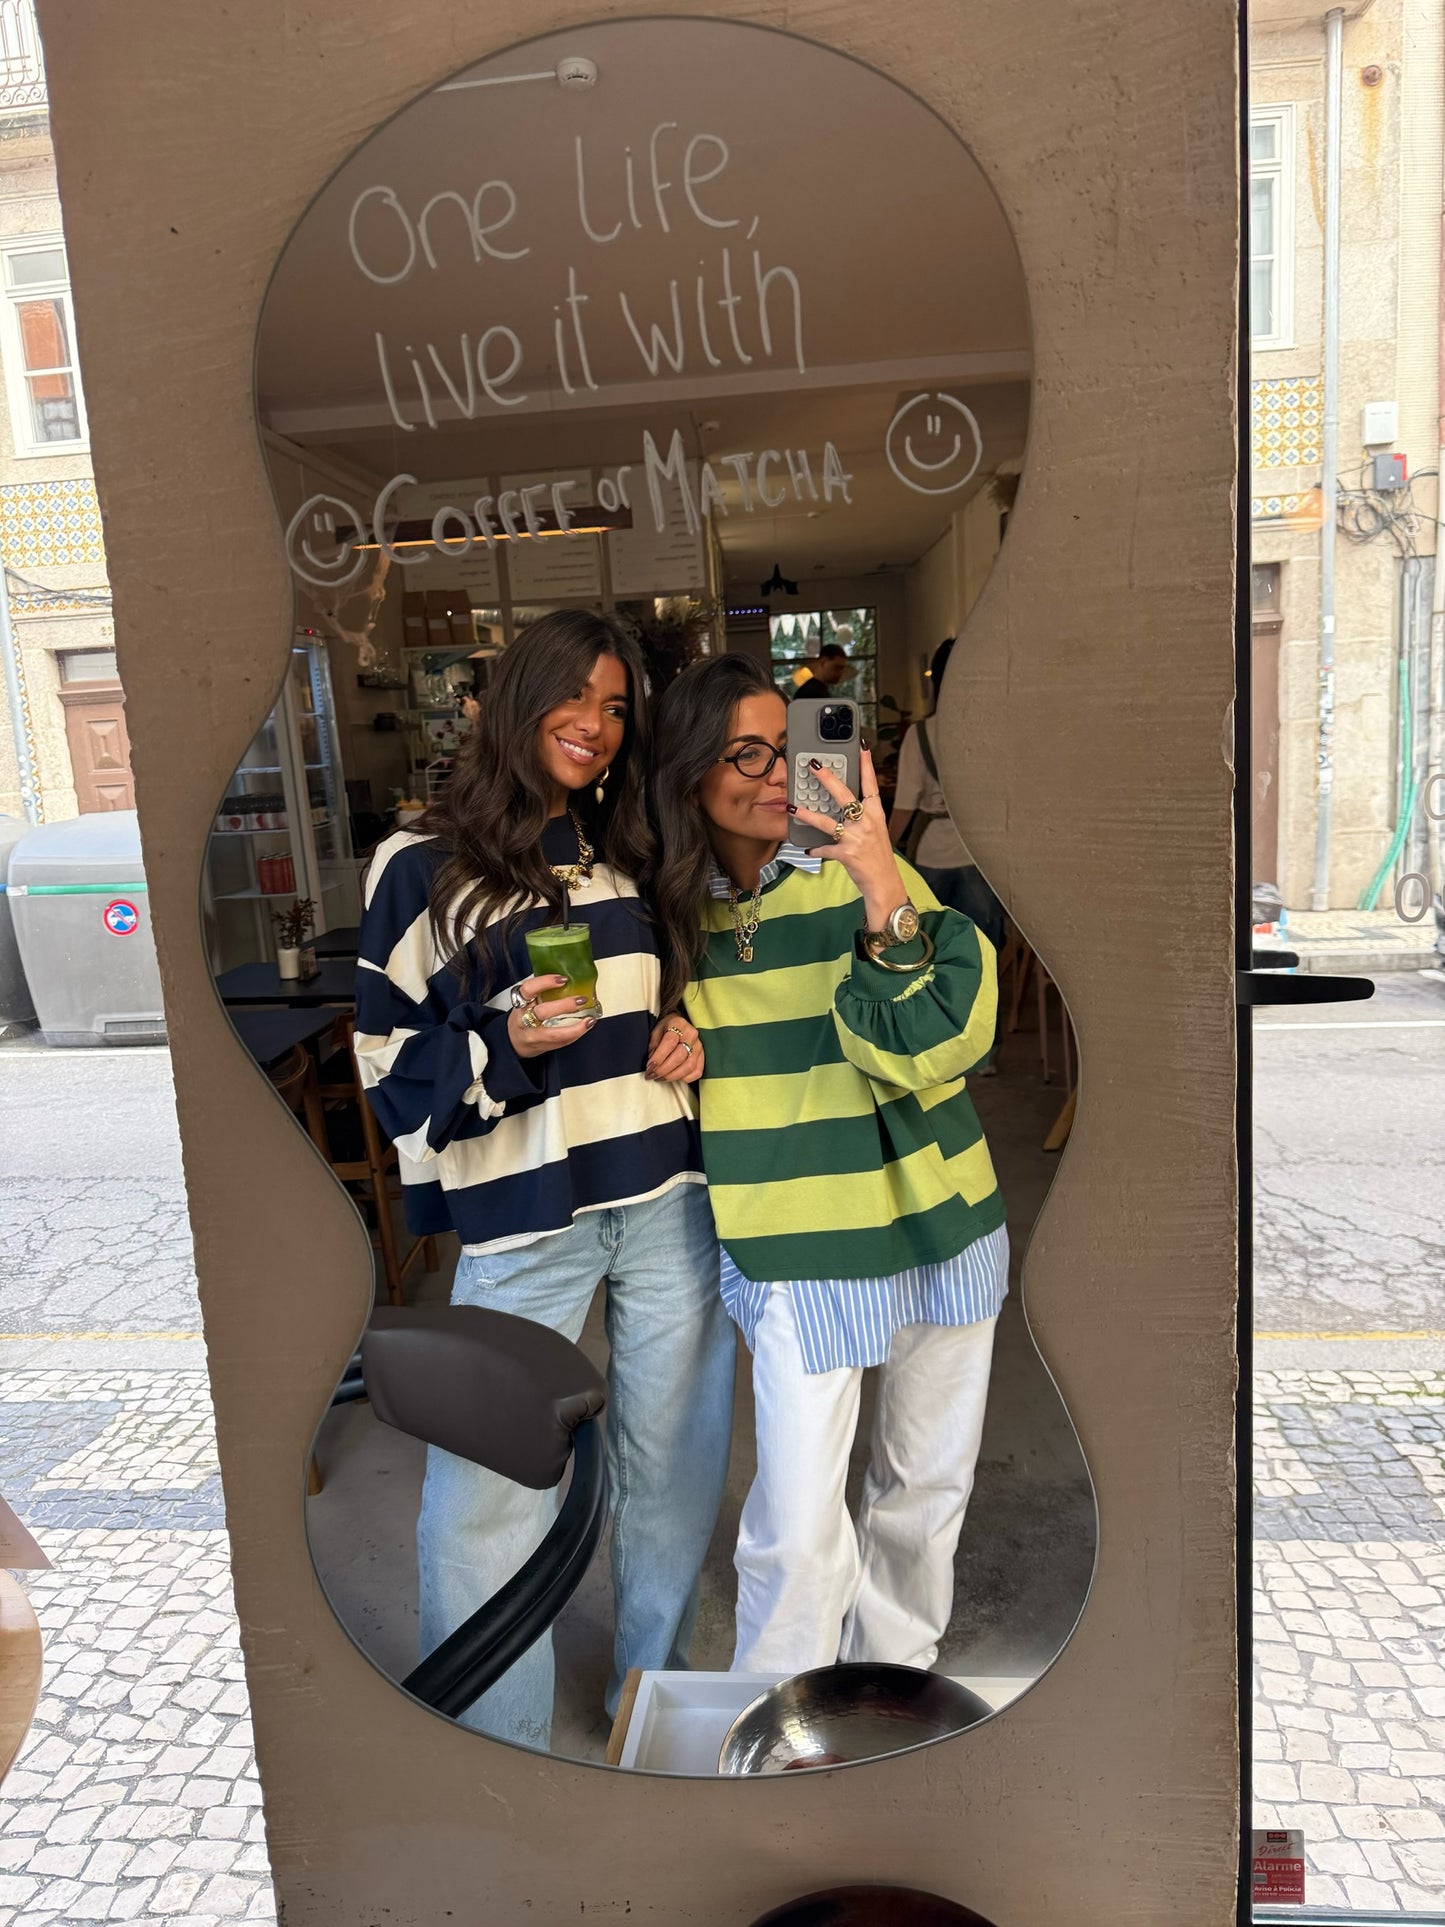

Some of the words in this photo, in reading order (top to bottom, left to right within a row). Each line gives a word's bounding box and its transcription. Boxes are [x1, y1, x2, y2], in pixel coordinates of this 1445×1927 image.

[348, 180, 530, 284] One
[375, 324, 529, 432] live
[552, 266, 599, 395] it
[618, 248, 806, 376] with
[596, 465, 632, 513] or
[643, 428, 854, 536] MATCHA
[1254, 1861, 1301, 1871] Alarme
